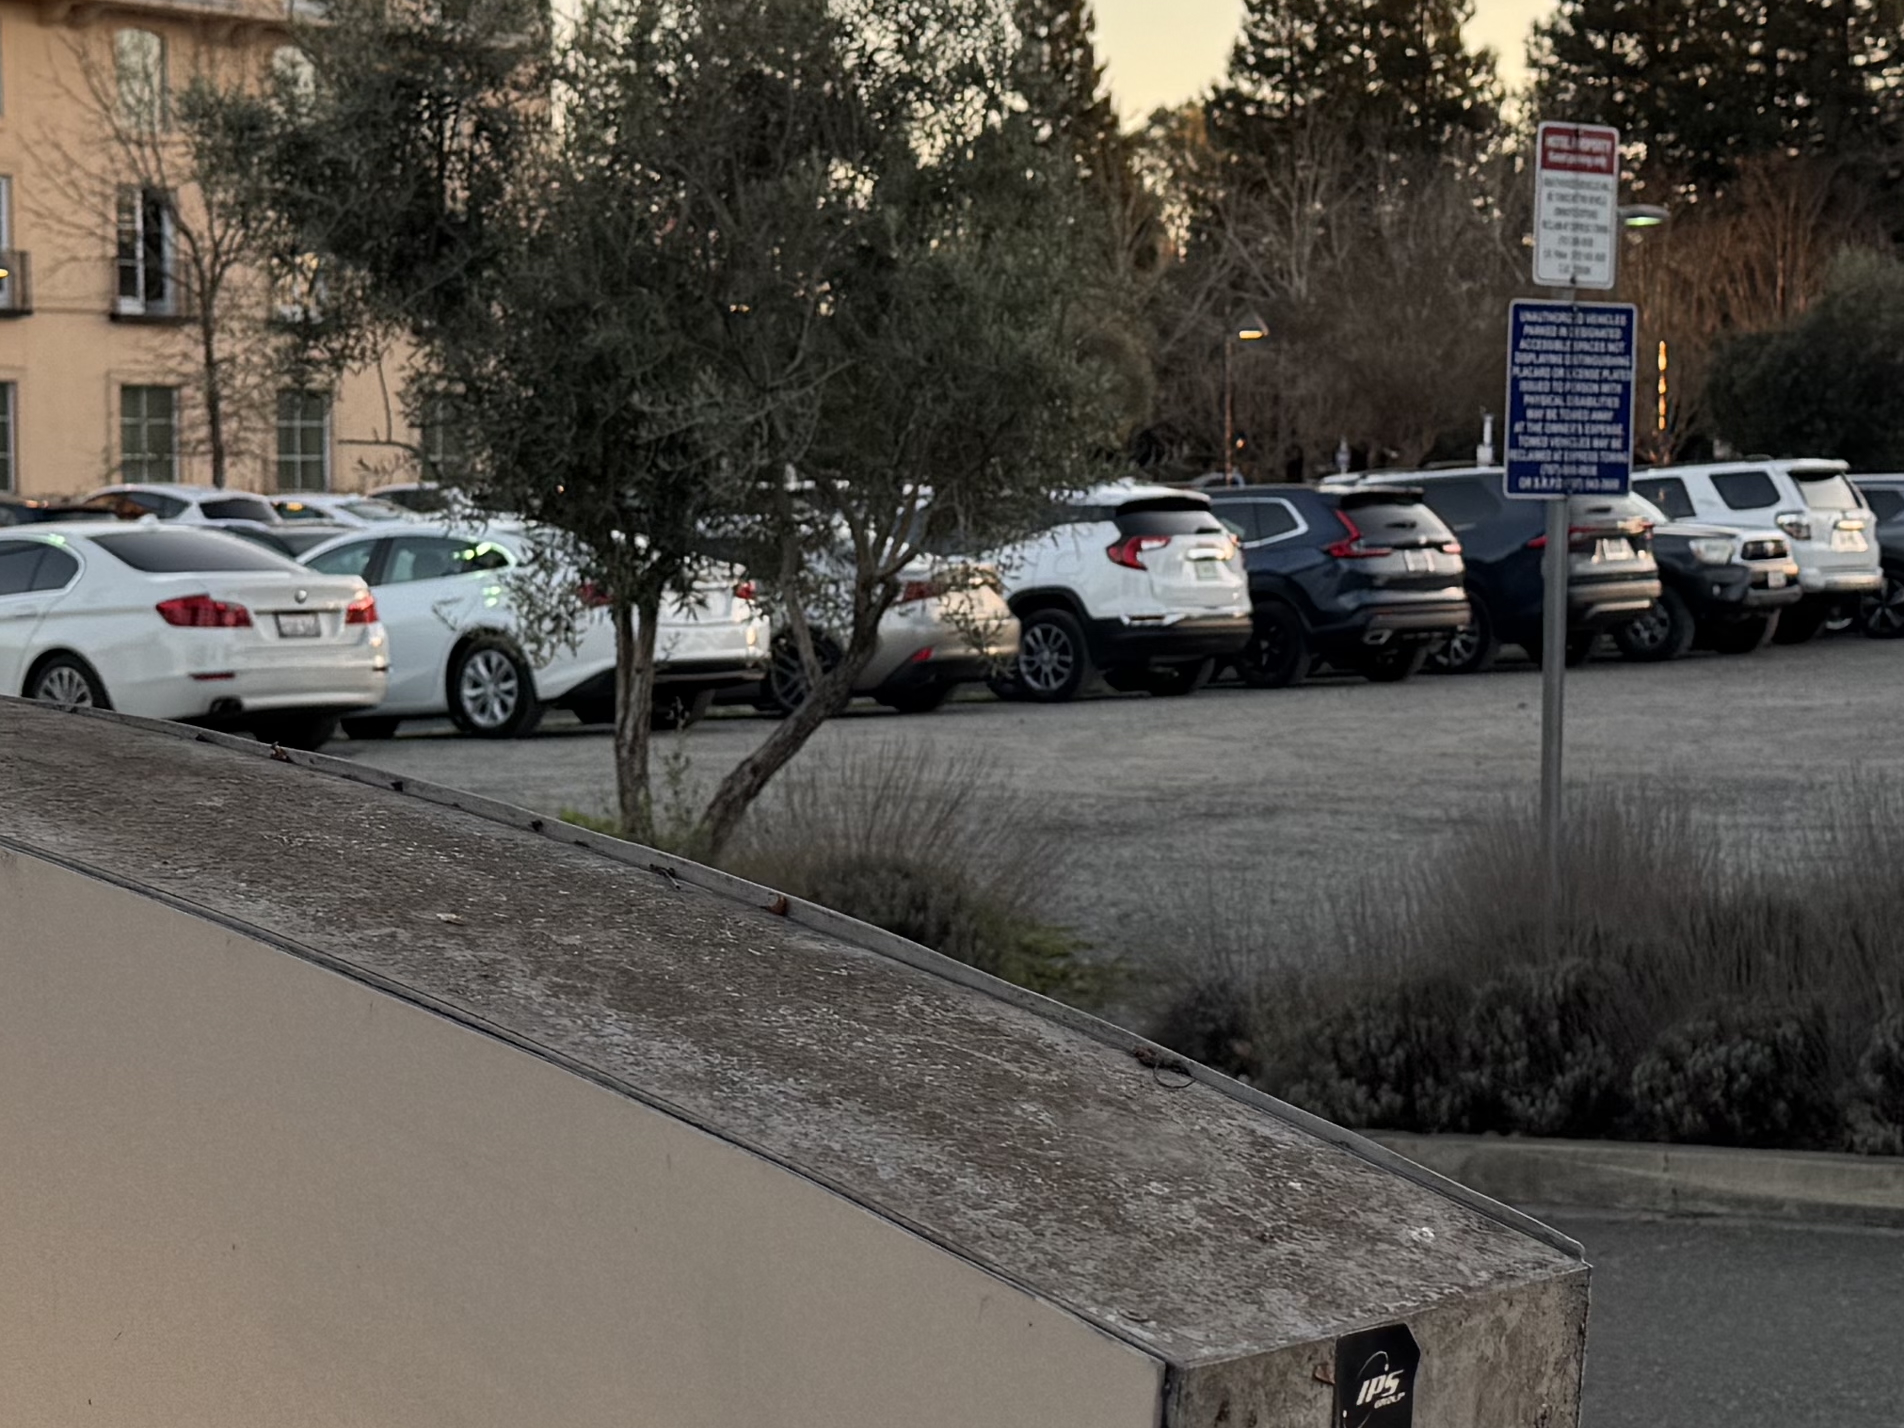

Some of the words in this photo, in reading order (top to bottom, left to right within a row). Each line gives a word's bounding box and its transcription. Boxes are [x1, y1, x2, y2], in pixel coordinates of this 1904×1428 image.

[1519, 310, 1583, 324] UNAUTHORIZD
[1564, 352, 1630, 366] DSTINGUISHING
[1356, 1369, 1404, 1406] IPS
